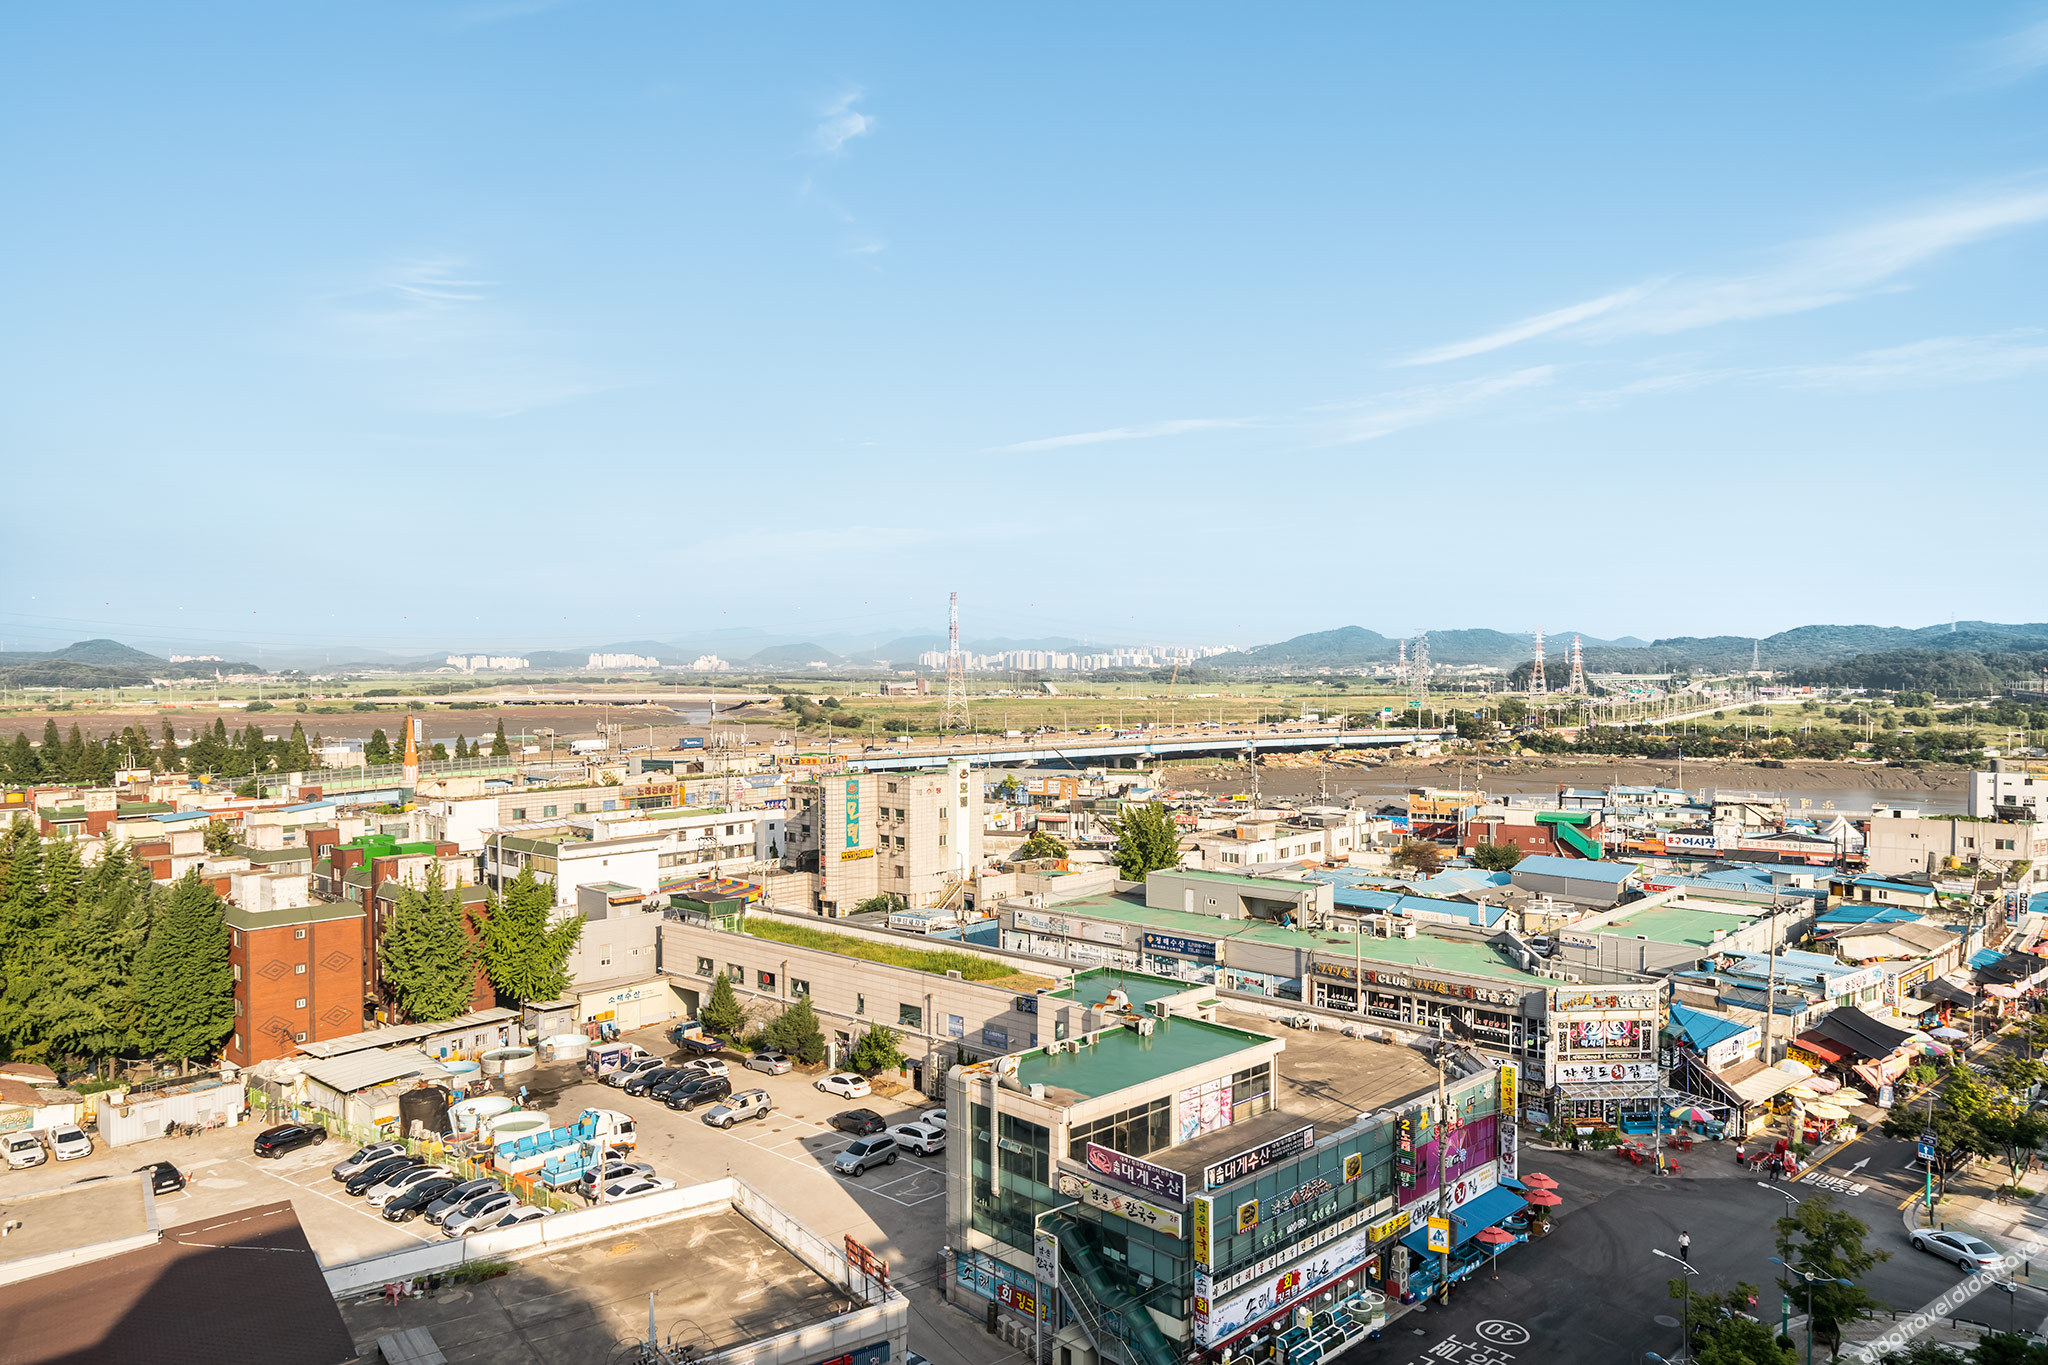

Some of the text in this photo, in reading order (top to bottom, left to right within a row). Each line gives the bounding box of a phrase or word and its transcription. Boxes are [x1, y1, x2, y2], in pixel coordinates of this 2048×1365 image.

[637, 784, 674, 797] 노래연습장
[847, 802, 859, 844] 모텔
[1668, 836, 1716, 849] 포구 어시장
[1378, 973, 1408, 987] CLUB
[1606, 1039, 1631, 1048] 노래방
[1401, 1120, 1410, 1131] 2
[1216, 1166, 1225, 1184] 소래
[1225, 1147, 1271, 1180] 대게수산
[1113, 1160, 1120, 1176] 소래
[1121, 1161, 1181, 1197] 대게수산
[1124, 1201, 1157, 1224] 칼국수
[1169, 1215, 1179, 1224] 2F
[1036, 1257, 1054, 1272] 칼국수
[962, 1265, 991, 1287] 소래
[1001, 1281, 1012, 1303] 회
[1283, 1272, 1293, 1290] 회
[1244, 1286, 1271, 1320] 소래
[1276, 1285, 1299, 1304] 킹크랩
[1196, 1301, 1208, 1313] 회
[1484, 1323, 1522, 1341] 30
